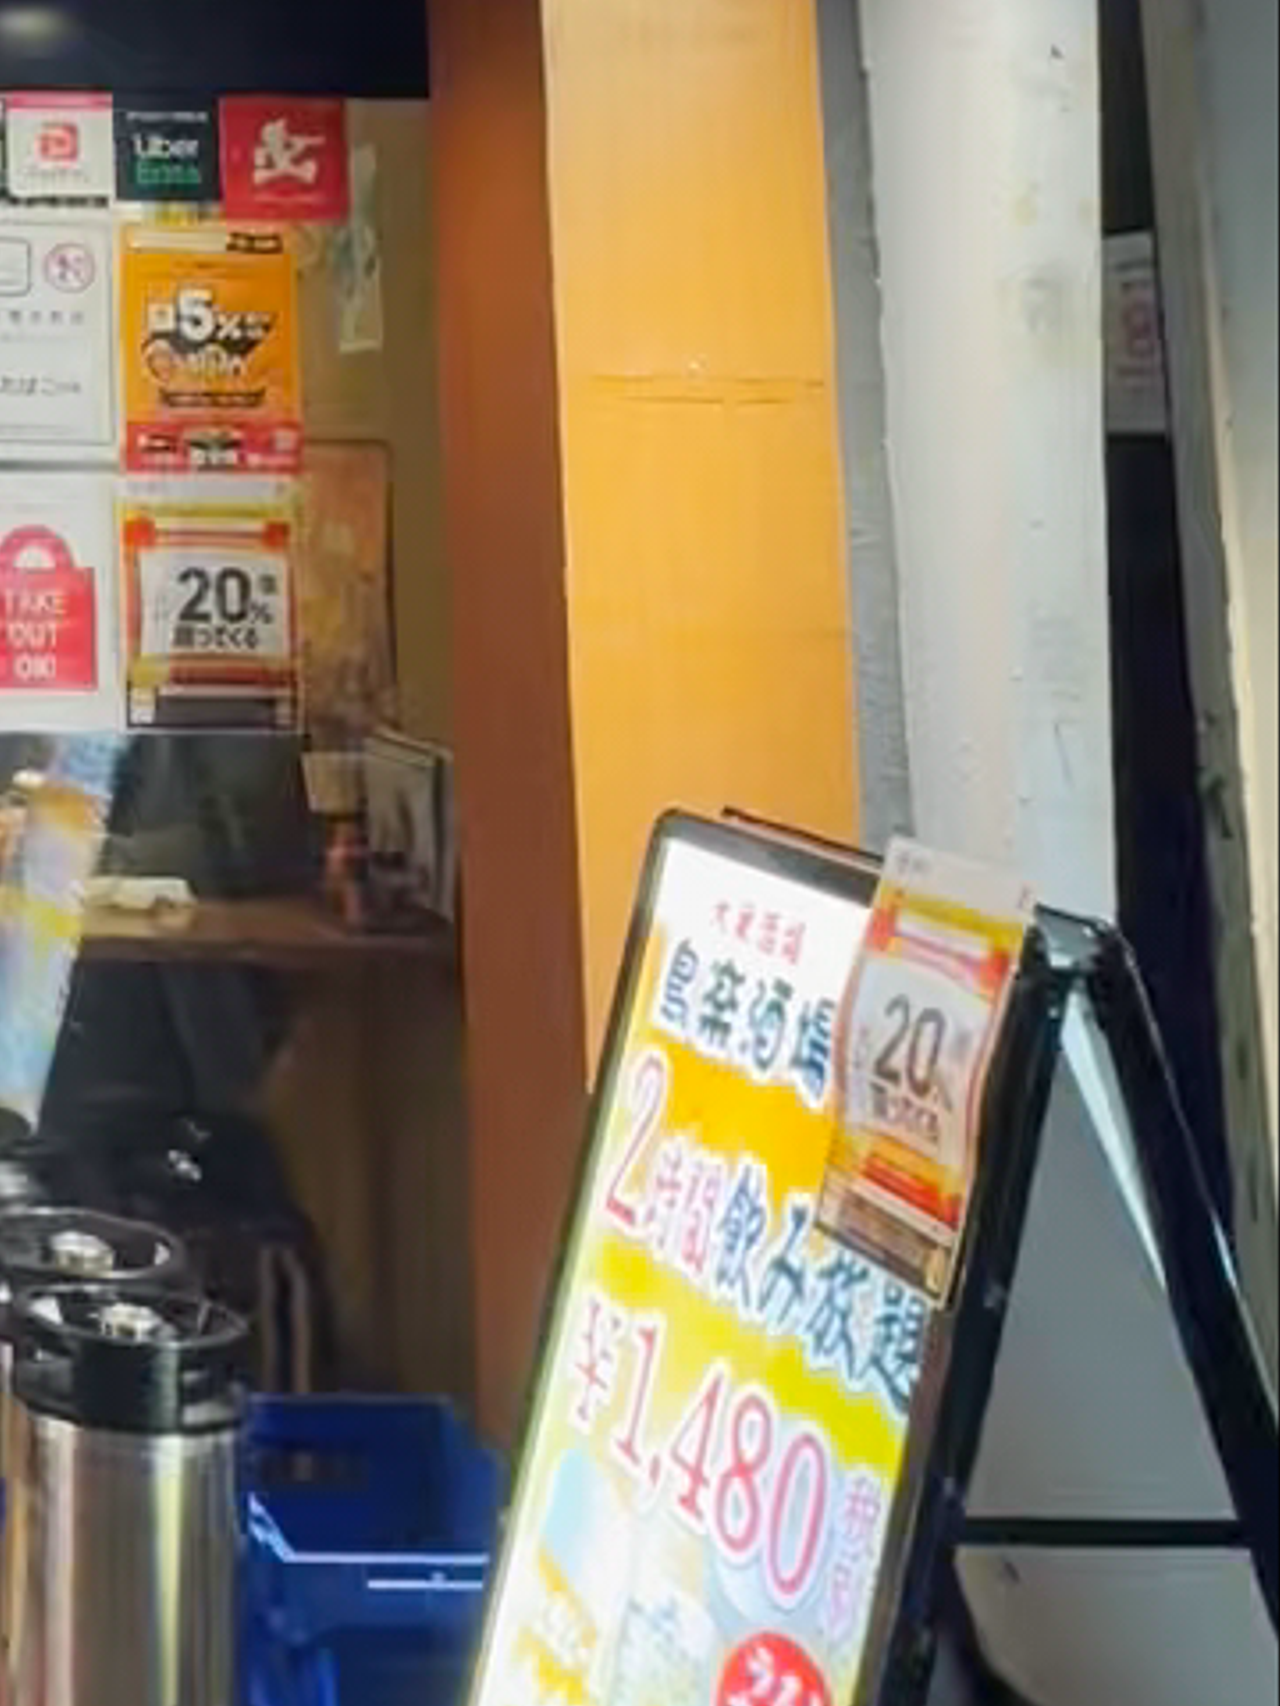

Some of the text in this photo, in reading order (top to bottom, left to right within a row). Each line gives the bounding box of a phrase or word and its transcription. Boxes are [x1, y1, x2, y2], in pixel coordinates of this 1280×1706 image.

[5, 590, 67, 614] TAKE
[7, 621, 58, 649] OUT
[176, 566, 274, 625] 20%
[660, 938, 836, 1102] 鳥楽酒場
[604, 1056, 928, 1416] 2時間飲み放題
[570, 1296, 830, 1598] ¥1,480
